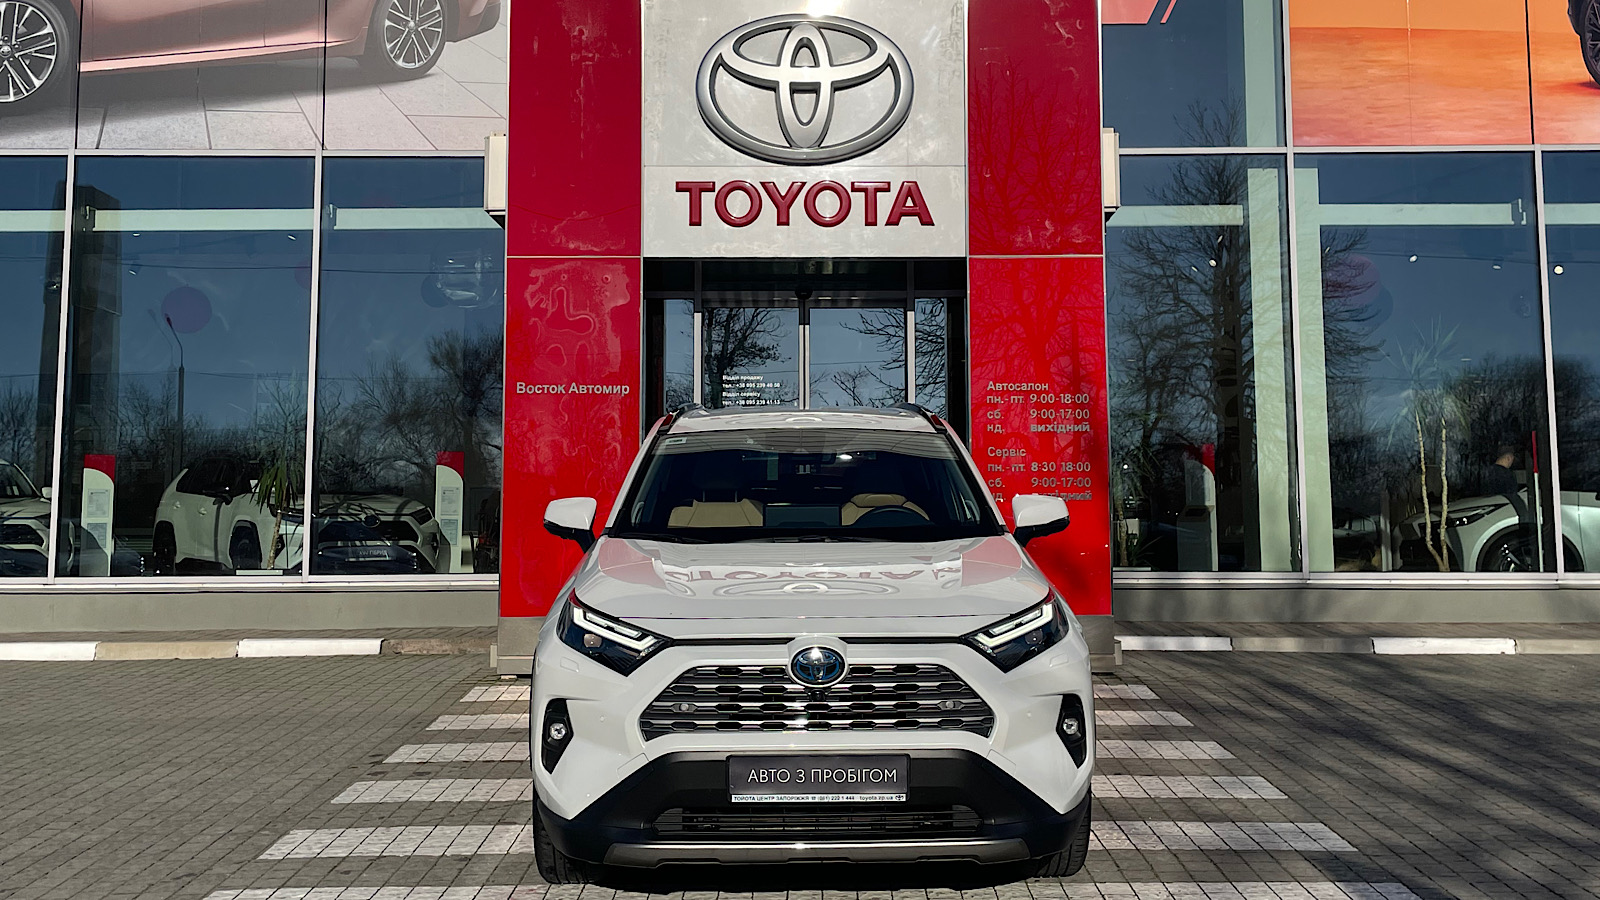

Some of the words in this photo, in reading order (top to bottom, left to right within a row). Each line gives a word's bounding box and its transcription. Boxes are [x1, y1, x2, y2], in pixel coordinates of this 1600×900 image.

[675, 180, 935, 227] TOYOTA
[516, 382, 566, 394] Восток
[568, 382, 630, 397] Автомир
[986, 381, 1049, 391] Автосалон
[986, 409, 1005, 419] сб.
[1030, 421, 1090, 433] вихідний
[987, 446, 1027, 458] Сервіс
[988, 477, 1005, 487] сб.
[747, 768, 791, 783] АВТО
[795, 768, 806, 783] З
[811, 768, 897, 783] ПРОБІГОМ
